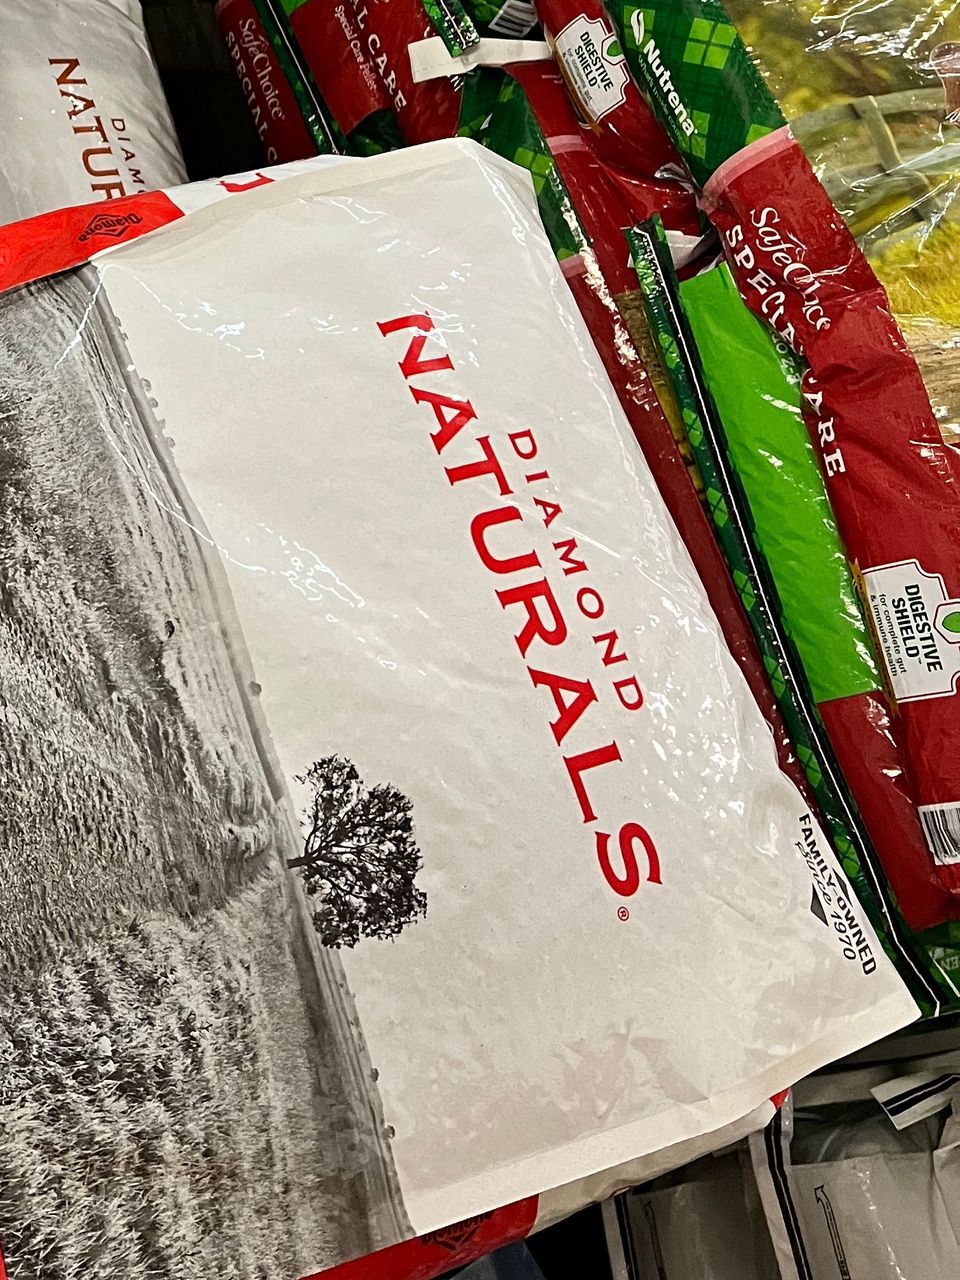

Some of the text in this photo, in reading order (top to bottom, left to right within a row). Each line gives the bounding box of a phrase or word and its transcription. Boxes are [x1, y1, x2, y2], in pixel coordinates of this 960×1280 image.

[225, 31, 269, 143] SPECIAL
[239, 18, 285, 121] SafeChoice
[350, 38, 365, 66] Care
[368, 32, 407, 113] CARE
[574, 47, 600, 90] SHIELD
[579, 31, 614, 92] DIGESTIVE
[642, 39, 696, 137] Nutrena
[78, 211, 143, 244] Diamond
[376, 310, 663, 899] NATURALS
[507, 428, 644, 711] DIAMOND
[872, 604, 887, 638] immune
[882, 640, 898, 677] health
[878, 593, 907, 674] for complete gut
[891, 597, 920, 661] SHIELD
[905, 585, 943, 673] DIGESTIVE
[795, 840, 856, 961] Since 1970
[799, 813, 877, 976] FAMILY-OWNED
